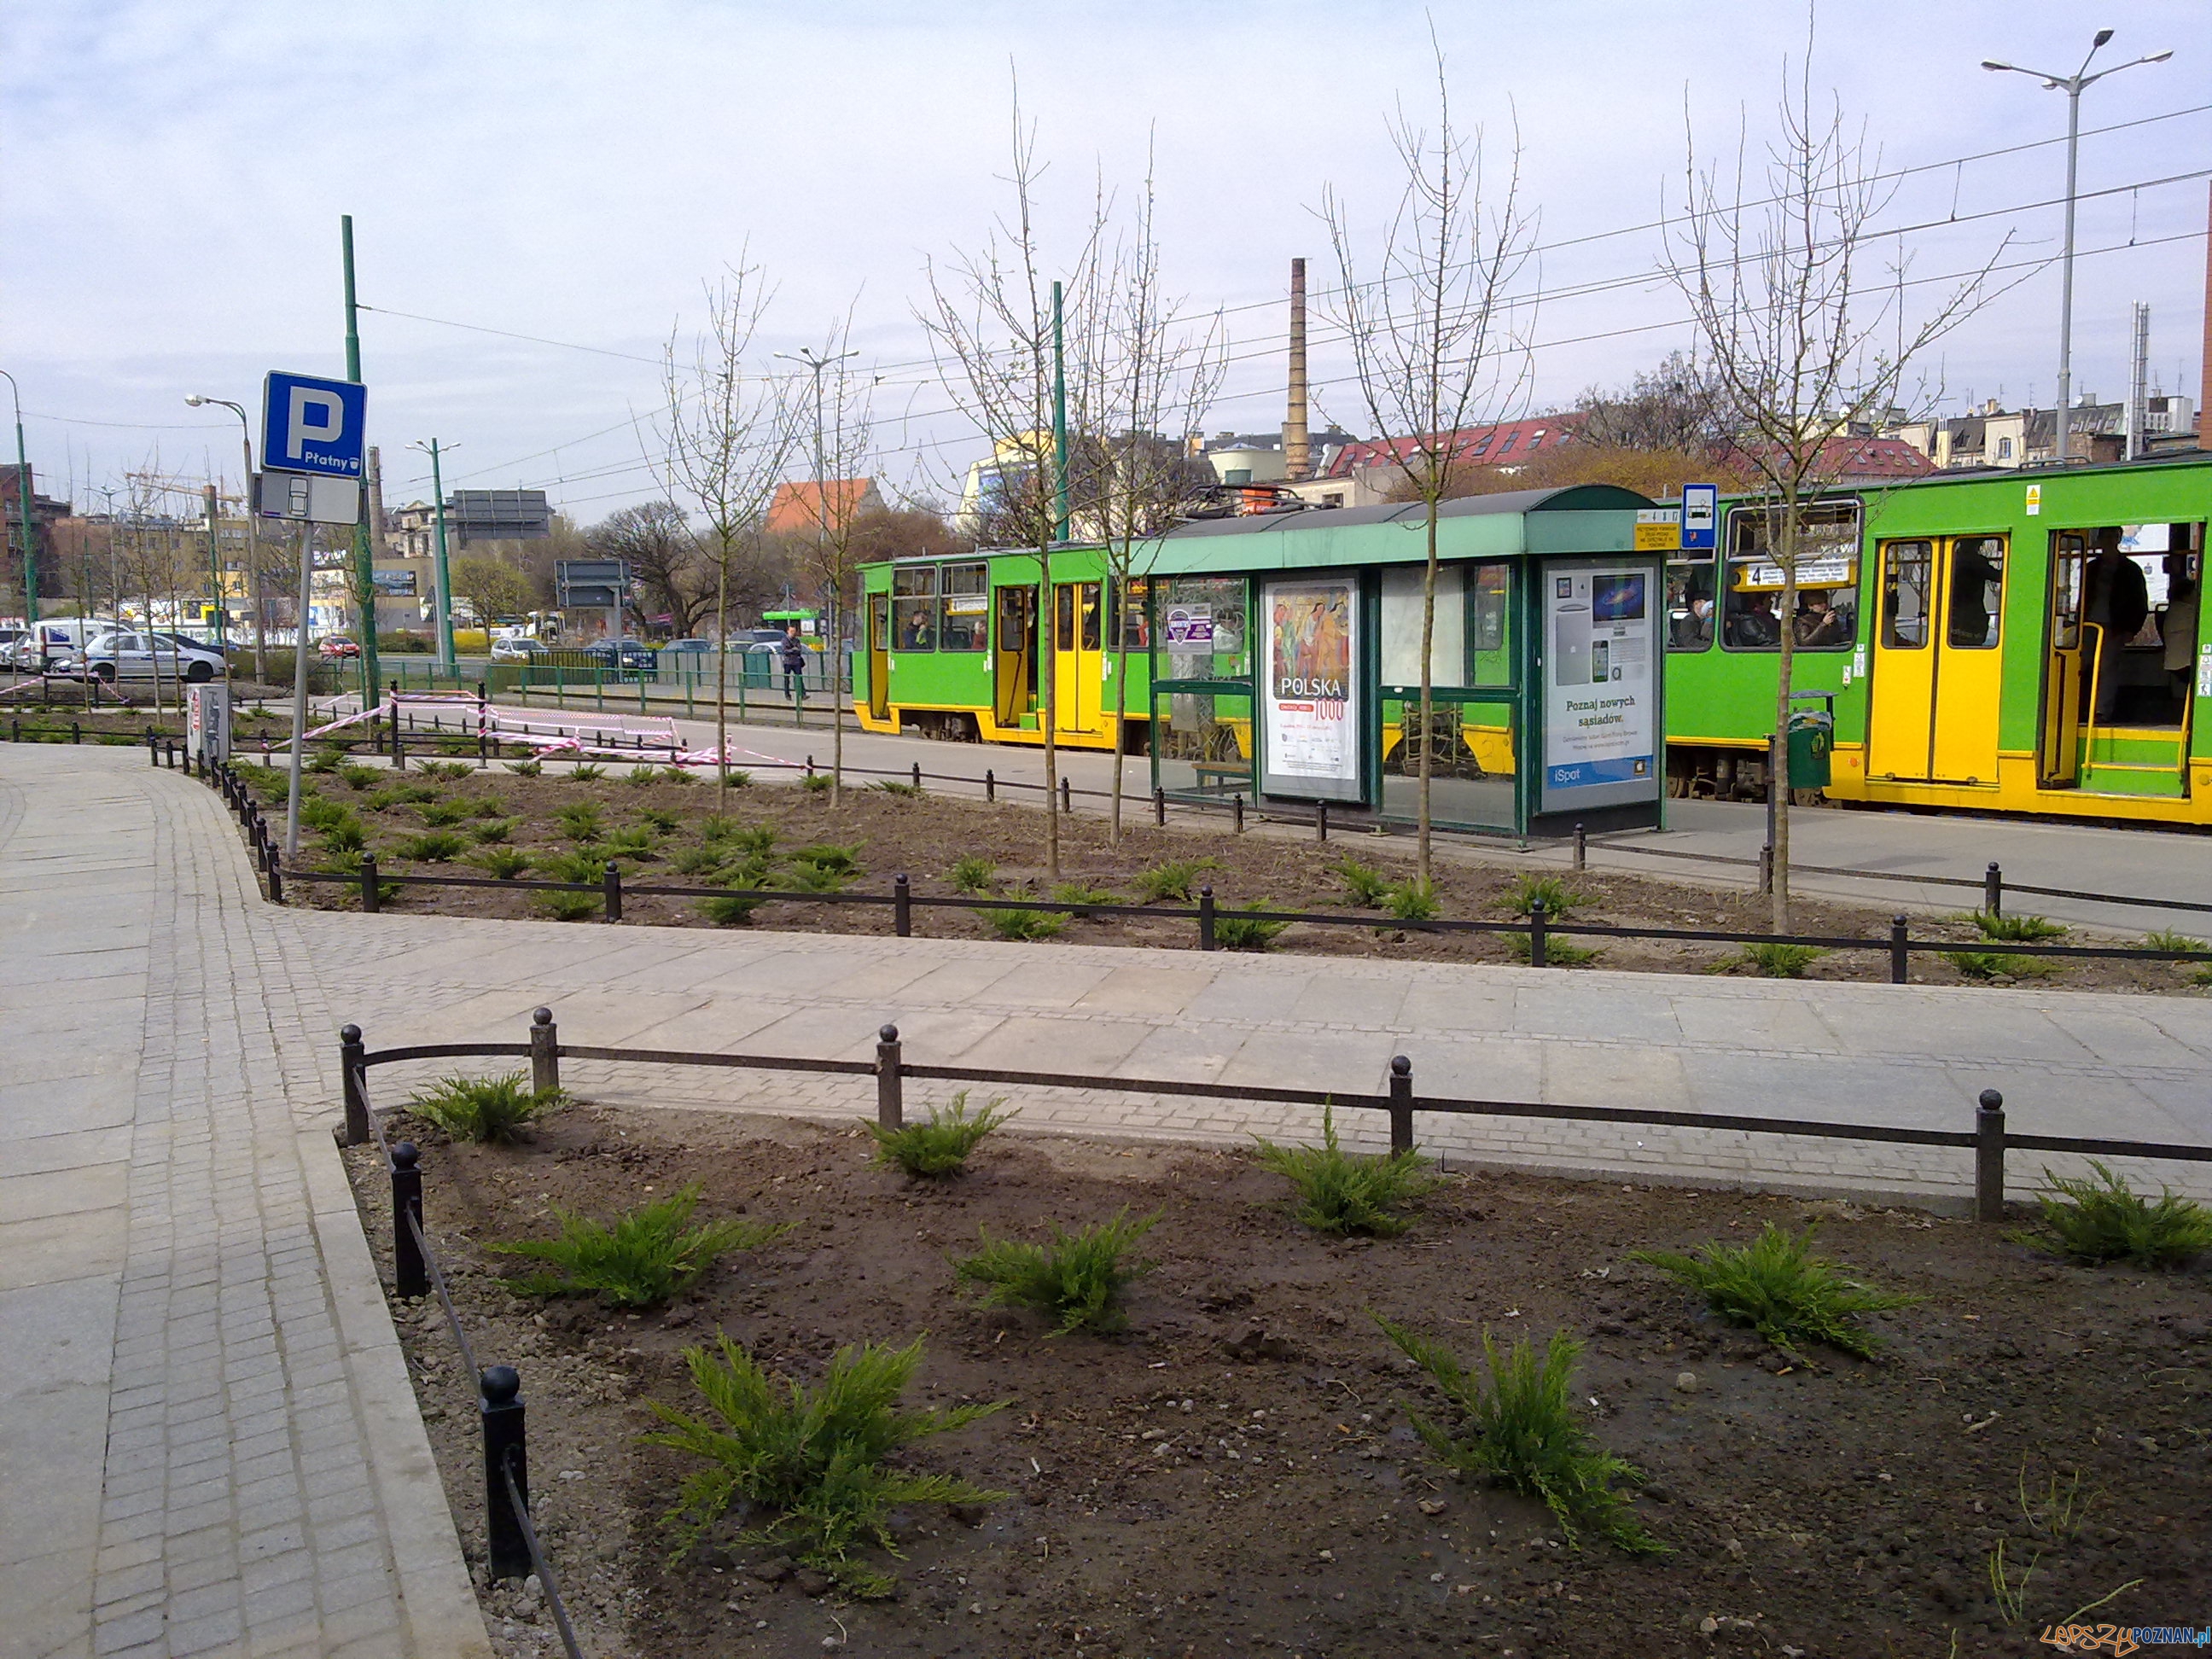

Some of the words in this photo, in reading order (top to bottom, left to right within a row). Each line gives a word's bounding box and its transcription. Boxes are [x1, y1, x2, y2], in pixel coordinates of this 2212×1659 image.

[287, 386, 344, 460] P
[305, 451, 348, 471] Płatny
[1752, 567, 1761, 585] 4
[1281, 678, 1342, 696] POLSKA
[1314, 697, 1344, 721] 1000
[1566, 698, 1598, 712] Poznaj
[1600, 695, 1636, 709] nowych
[1578, 713, 1624, 729] sąsiadów.
[1554, 768, 1580, 783] iSpot
